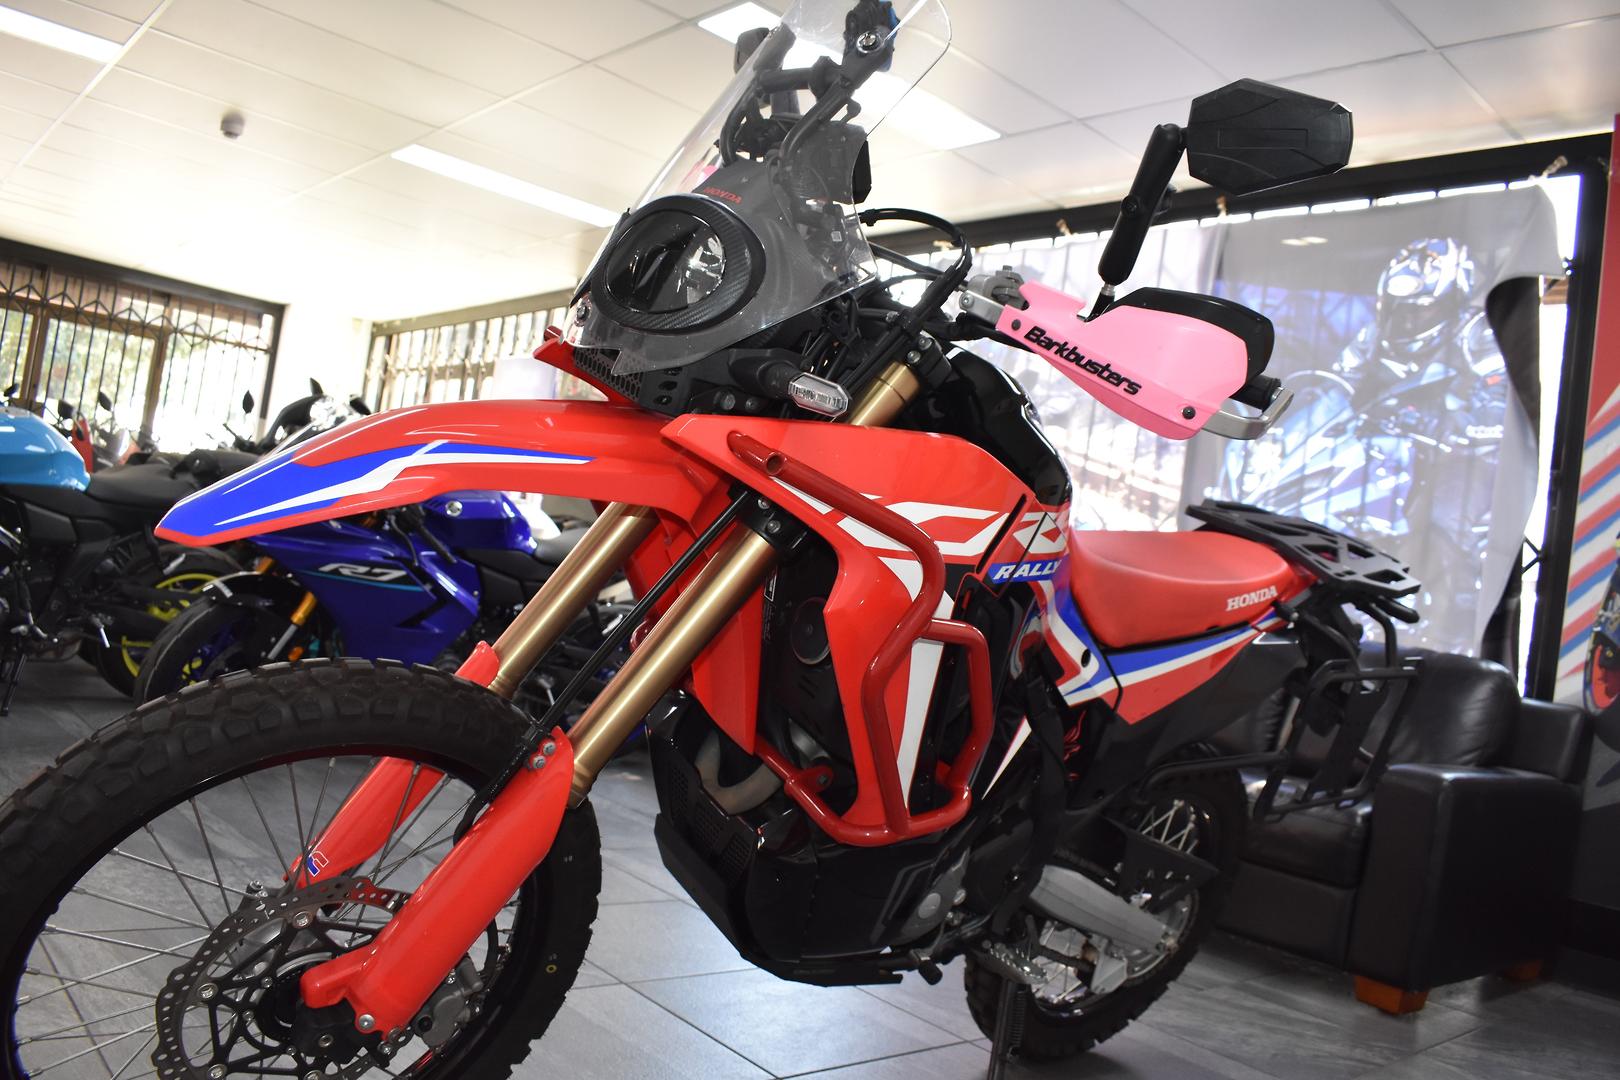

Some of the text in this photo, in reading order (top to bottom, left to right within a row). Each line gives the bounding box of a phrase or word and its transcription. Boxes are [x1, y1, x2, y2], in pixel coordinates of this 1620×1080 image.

[704, 187, 742, 204] HONDA
[1024, 326, 1142, 395] Barkbusters
[318, 563, 407, 581] R7
[993, 560, 1061, 579] RALLY
[1226, 586, 1278, 612] HONDA
